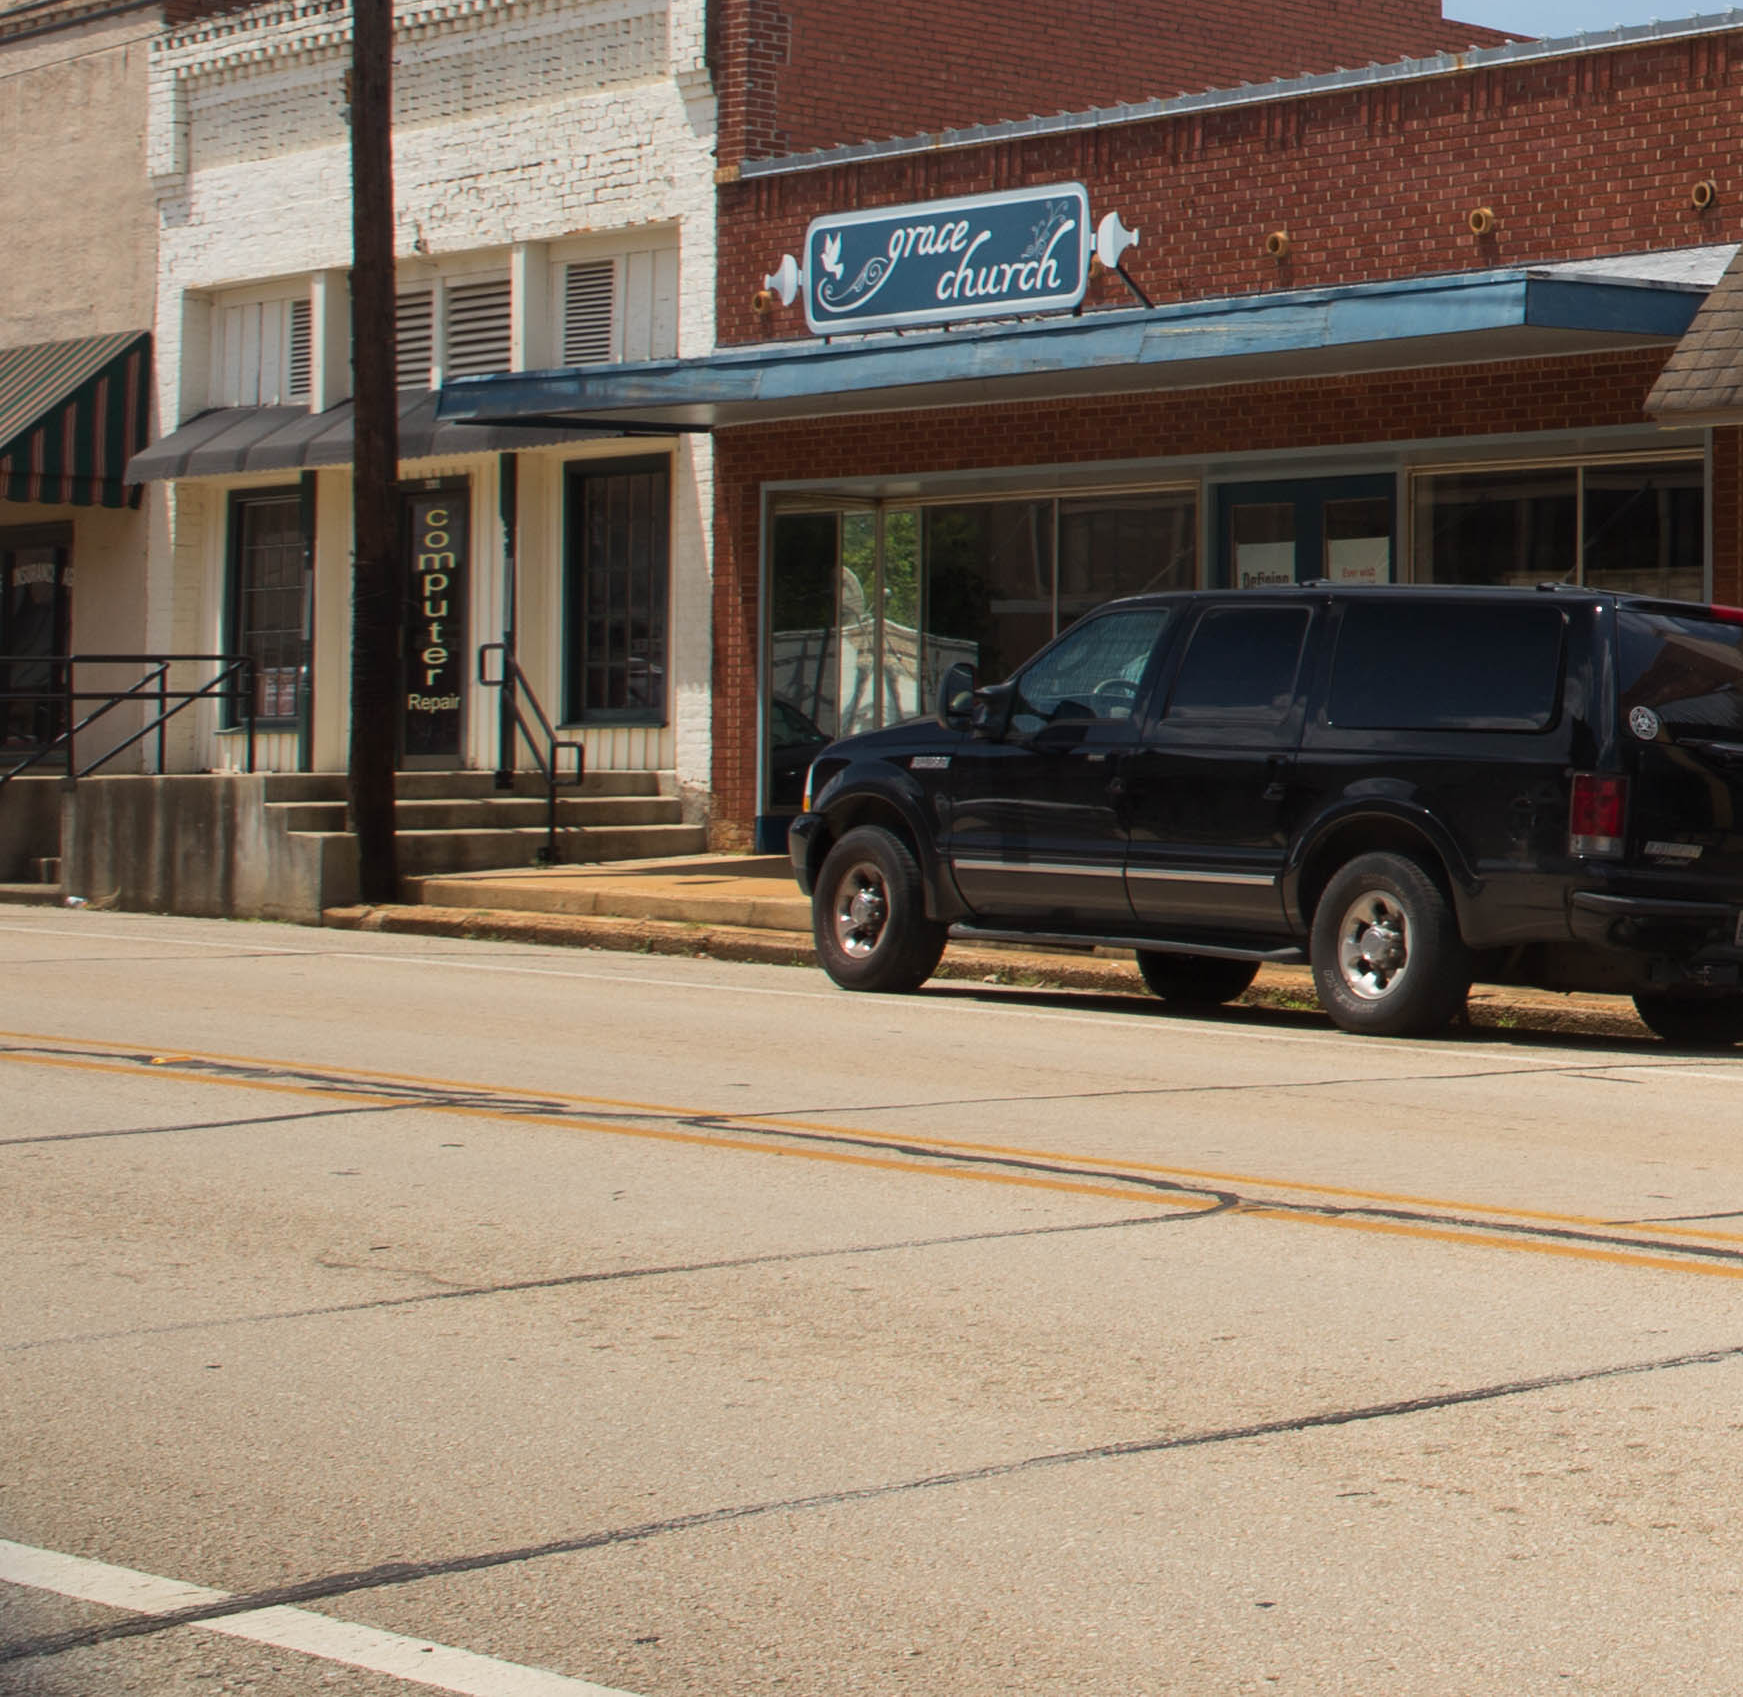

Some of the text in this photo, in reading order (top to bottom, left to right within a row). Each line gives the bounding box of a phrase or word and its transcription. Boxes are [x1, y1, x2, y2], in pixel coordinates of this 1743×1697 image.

[880, 219, 971, 265] grace
[935, 219, 1076, 300] church
[416, 508, 458, 687] computer
[407, 693, 462, 715] Repair
